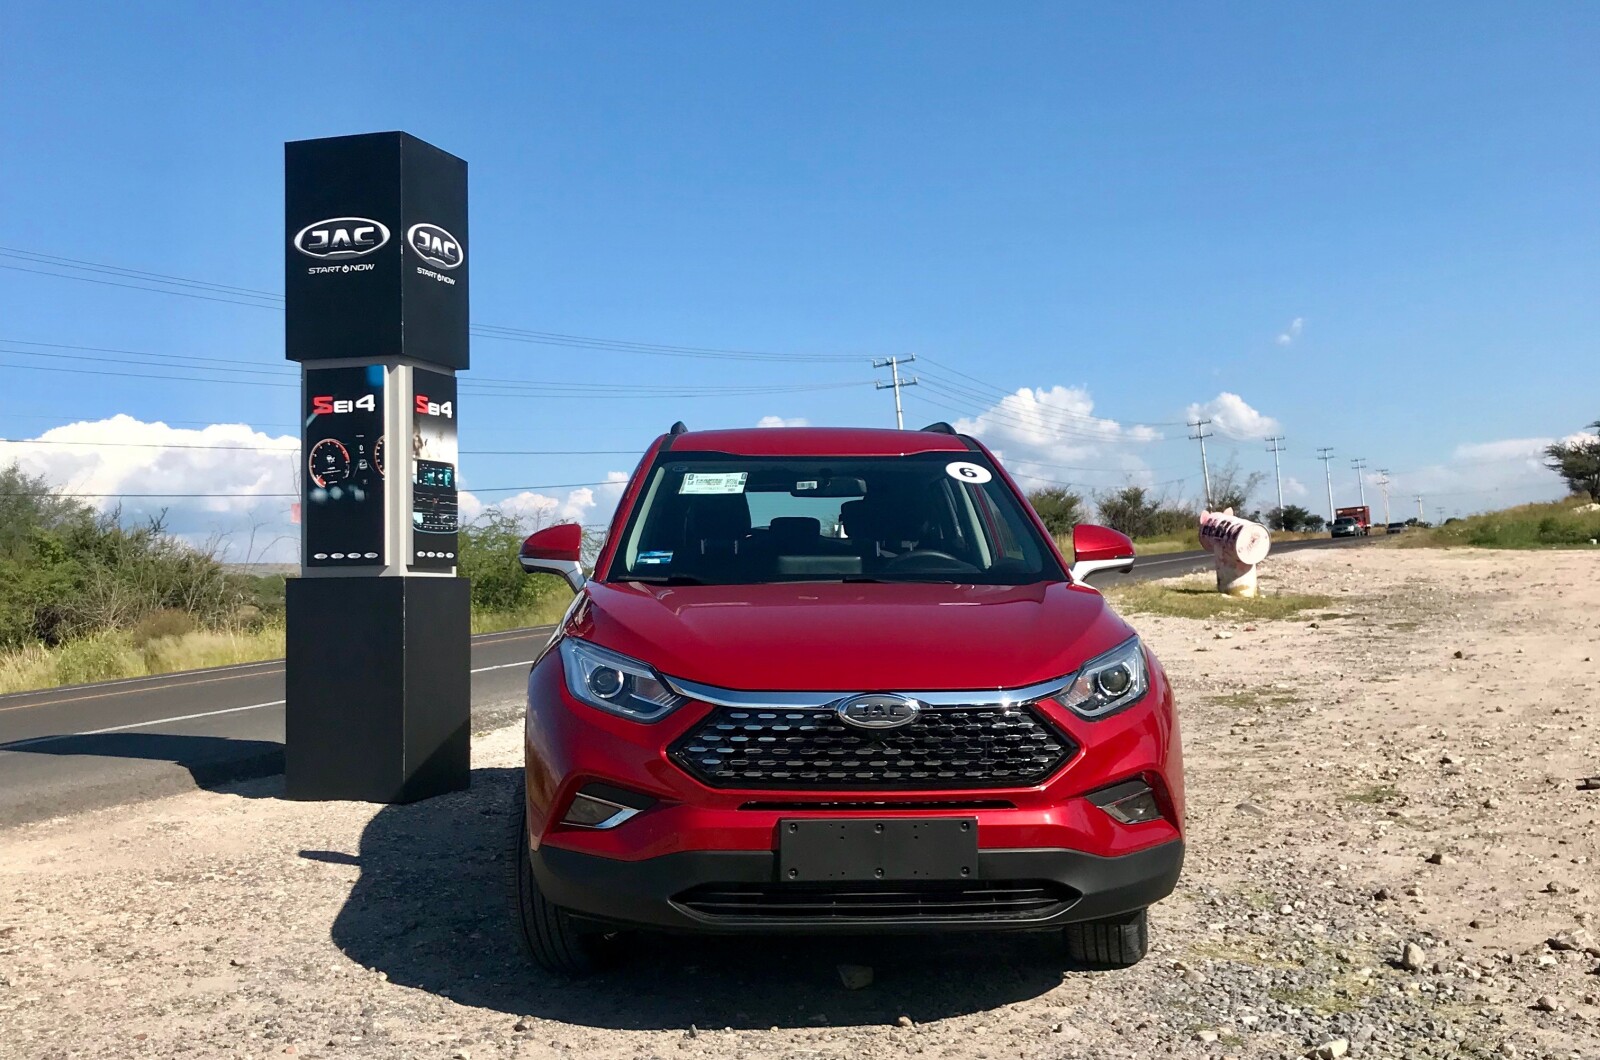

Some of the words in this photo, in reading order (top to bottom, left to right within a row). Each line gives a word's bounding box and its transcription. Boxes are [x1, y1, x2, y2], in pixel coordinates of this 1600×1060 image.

[308, 226, 375, 250] JAC
[417, 230, 456, 262] JAC
[308, 265, 342, 275] START
[350, 263, 375, 272] NOW
[416, 266, 437, 278] START
[442, 275, 456, 286] NOW
[959, 467, 978, 478] 6
[853, 704, 905, 718] JAC
